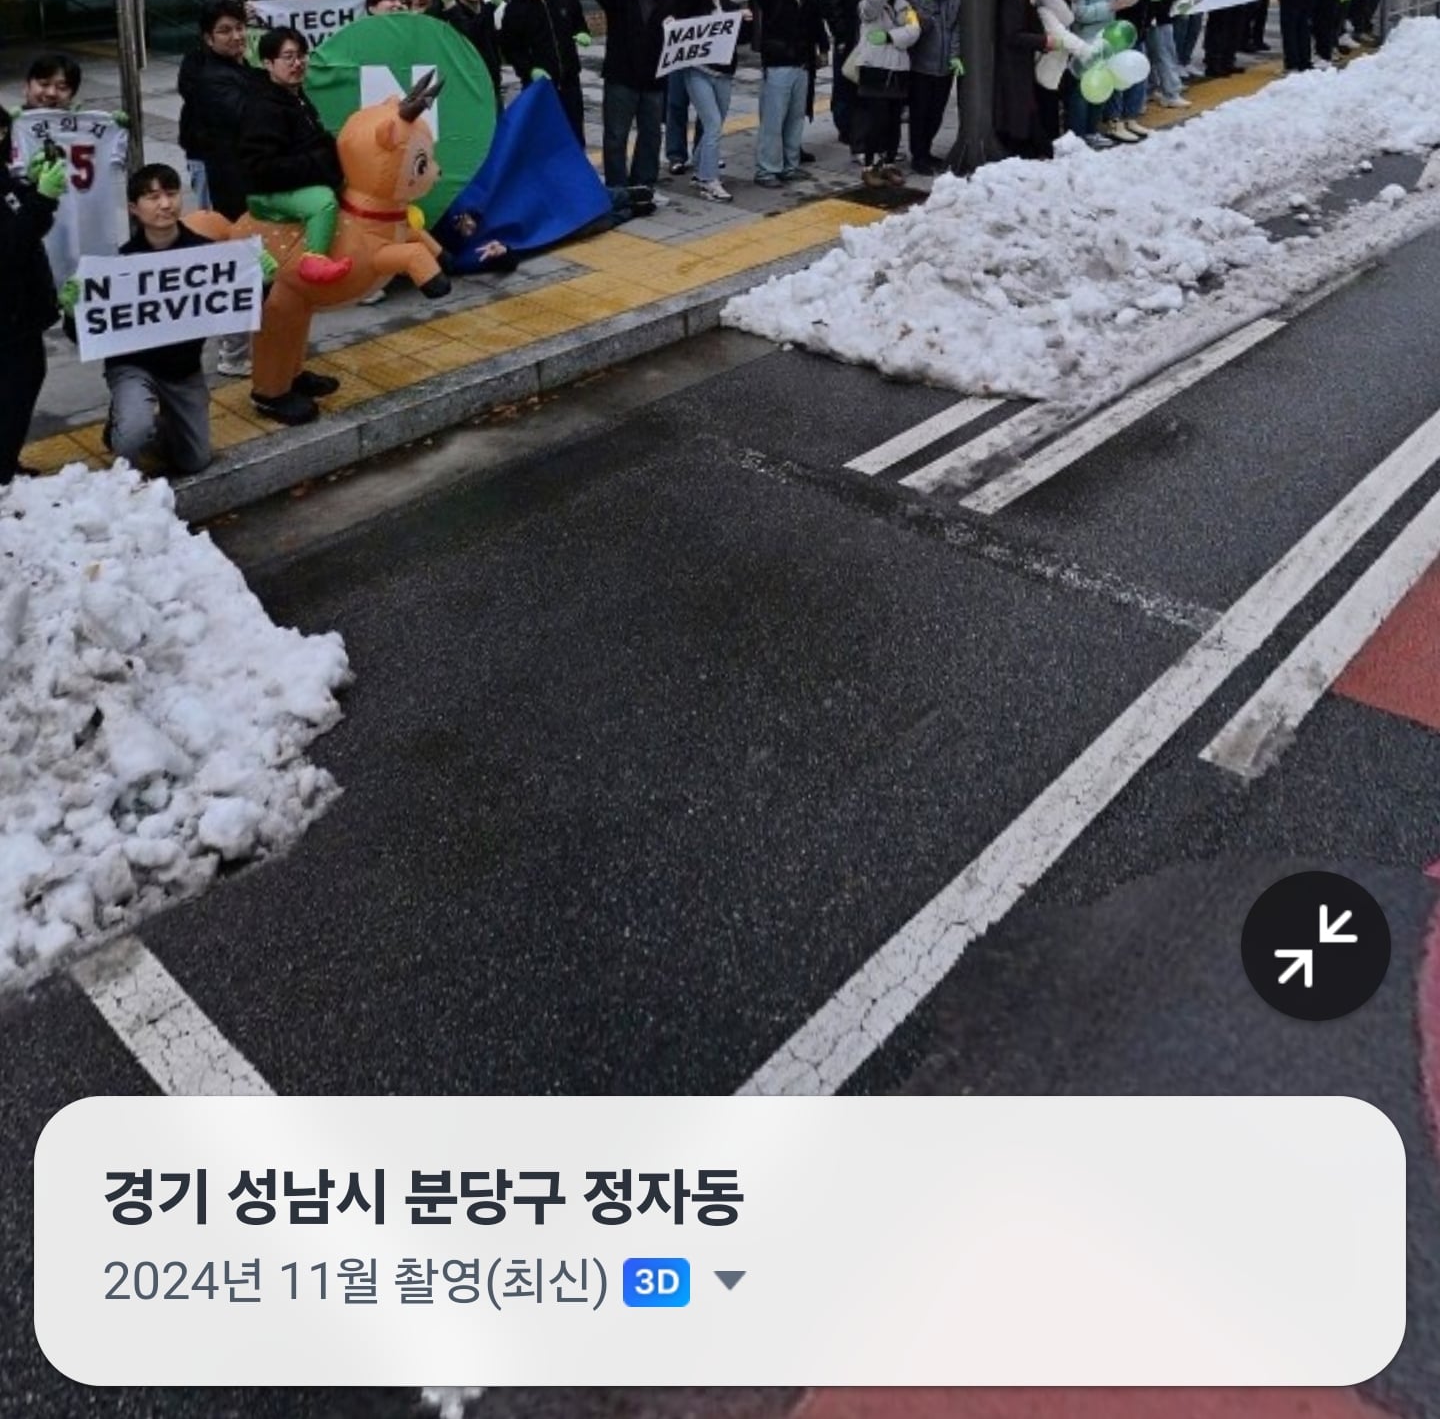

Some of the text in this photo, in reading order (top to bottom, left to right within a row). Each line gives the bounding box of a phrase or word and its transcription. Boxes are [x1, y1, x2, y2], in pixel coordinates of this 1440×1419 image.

[668, 19, 735, 46] NAVER
[661, 41, 713, 68] LABS
[86, 287, 254, 335] SERVICE
